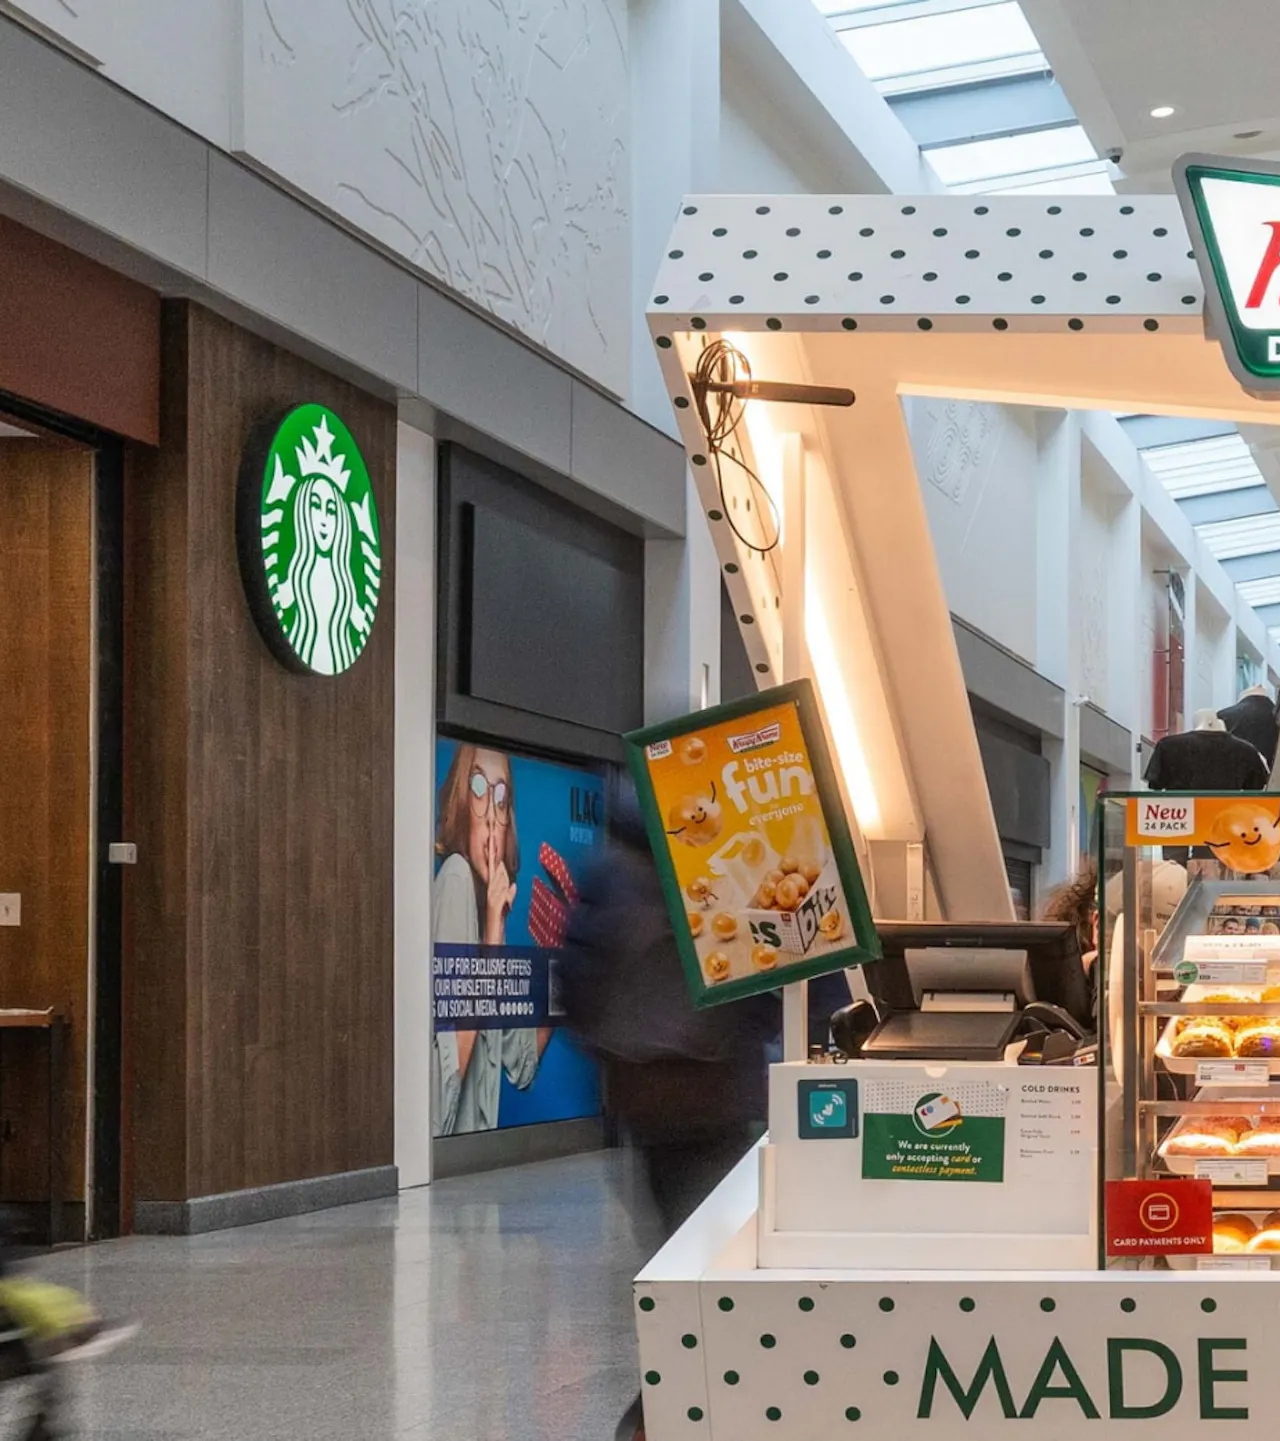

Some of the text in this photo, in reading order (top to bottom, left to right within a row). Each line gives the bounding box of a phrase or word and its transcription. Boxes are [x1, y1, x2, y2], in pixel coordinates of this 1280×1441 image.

[744, 751, 803, 773] bite-size
[722, 760, 812, 813] fun
[1145, 804, 1188, 820] New
[1144, 822, 1187, 831] 24 PACK
[445, 957, 532, 976] UP FOR EXCLUSIVE OFFERS
[435, 979, 450, 996] OUR
[452, 979, 496, 996] NEWSLETTER
[504, 979, 530, 996] FOLLOW
[437, 1000, 448, 1017] ON
[449, 999, 474, 1016] SOCIAL
[898, 1140, 971, 1154] We are currently
[886, 1152, 982, 1165] only accepting card or
[892, 1164, 937, 1174] contactless
[1113, 1236, 1206, 1246] CARD PAYMENTS ONLY
[915, 1336, 1250, 1420] MADE
